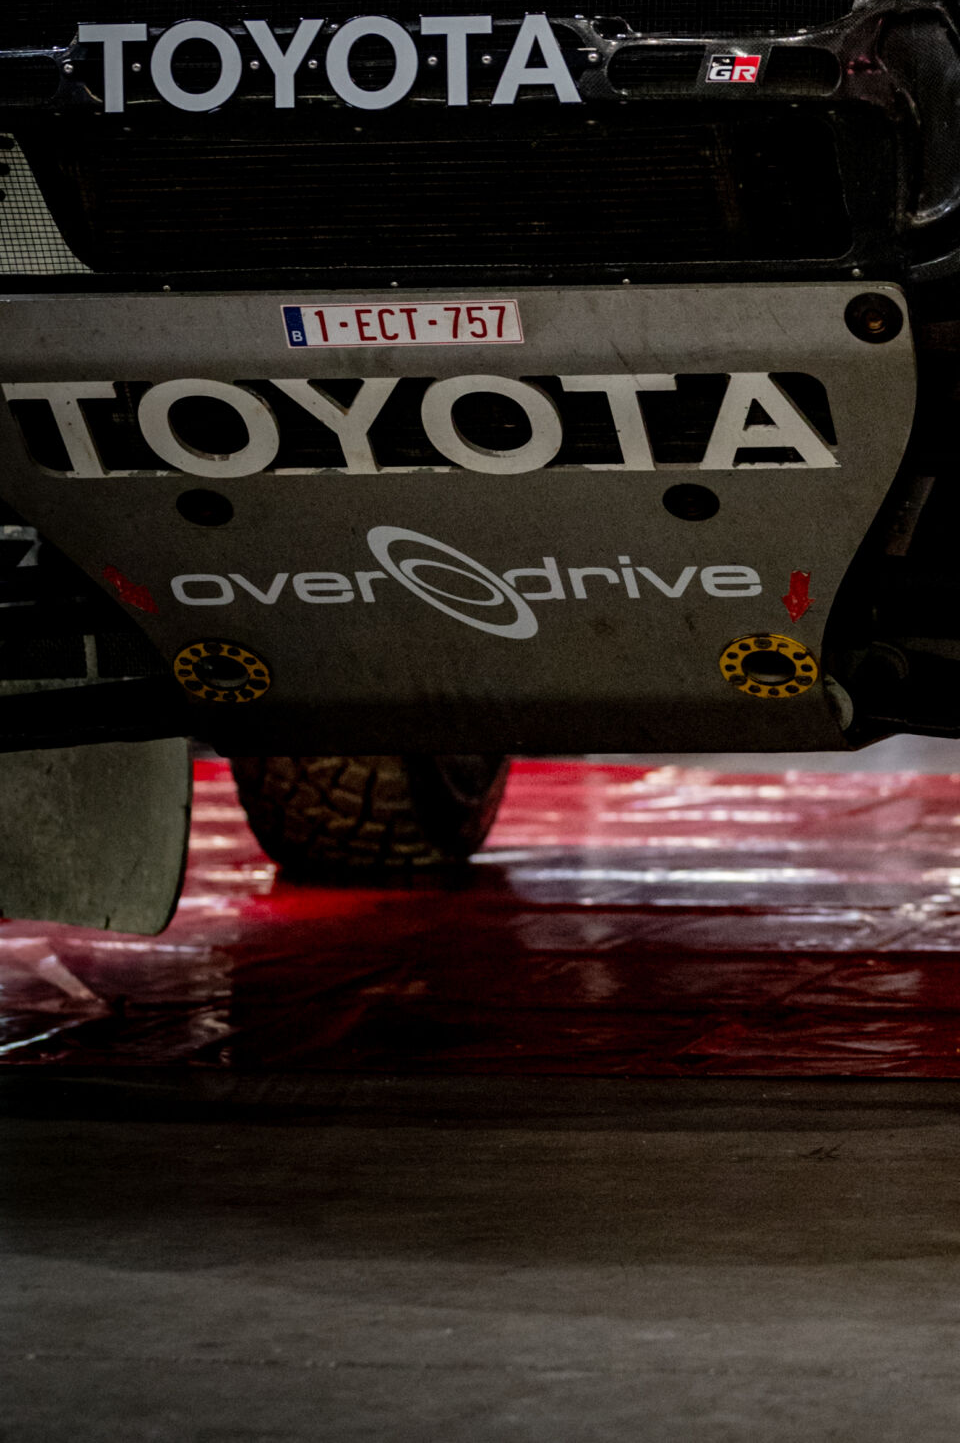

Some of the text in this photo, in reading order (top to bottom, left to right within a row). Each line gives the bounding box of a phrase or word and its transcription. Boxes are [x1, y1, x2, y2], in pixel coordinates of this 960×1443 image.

[78, 12, 583, 113] TOYOTA
[709, 65, 757, 81] GR
[291, 306, 506, 343] B 1-ECT-757
[2, 372, 842, 479] TOYOTA
